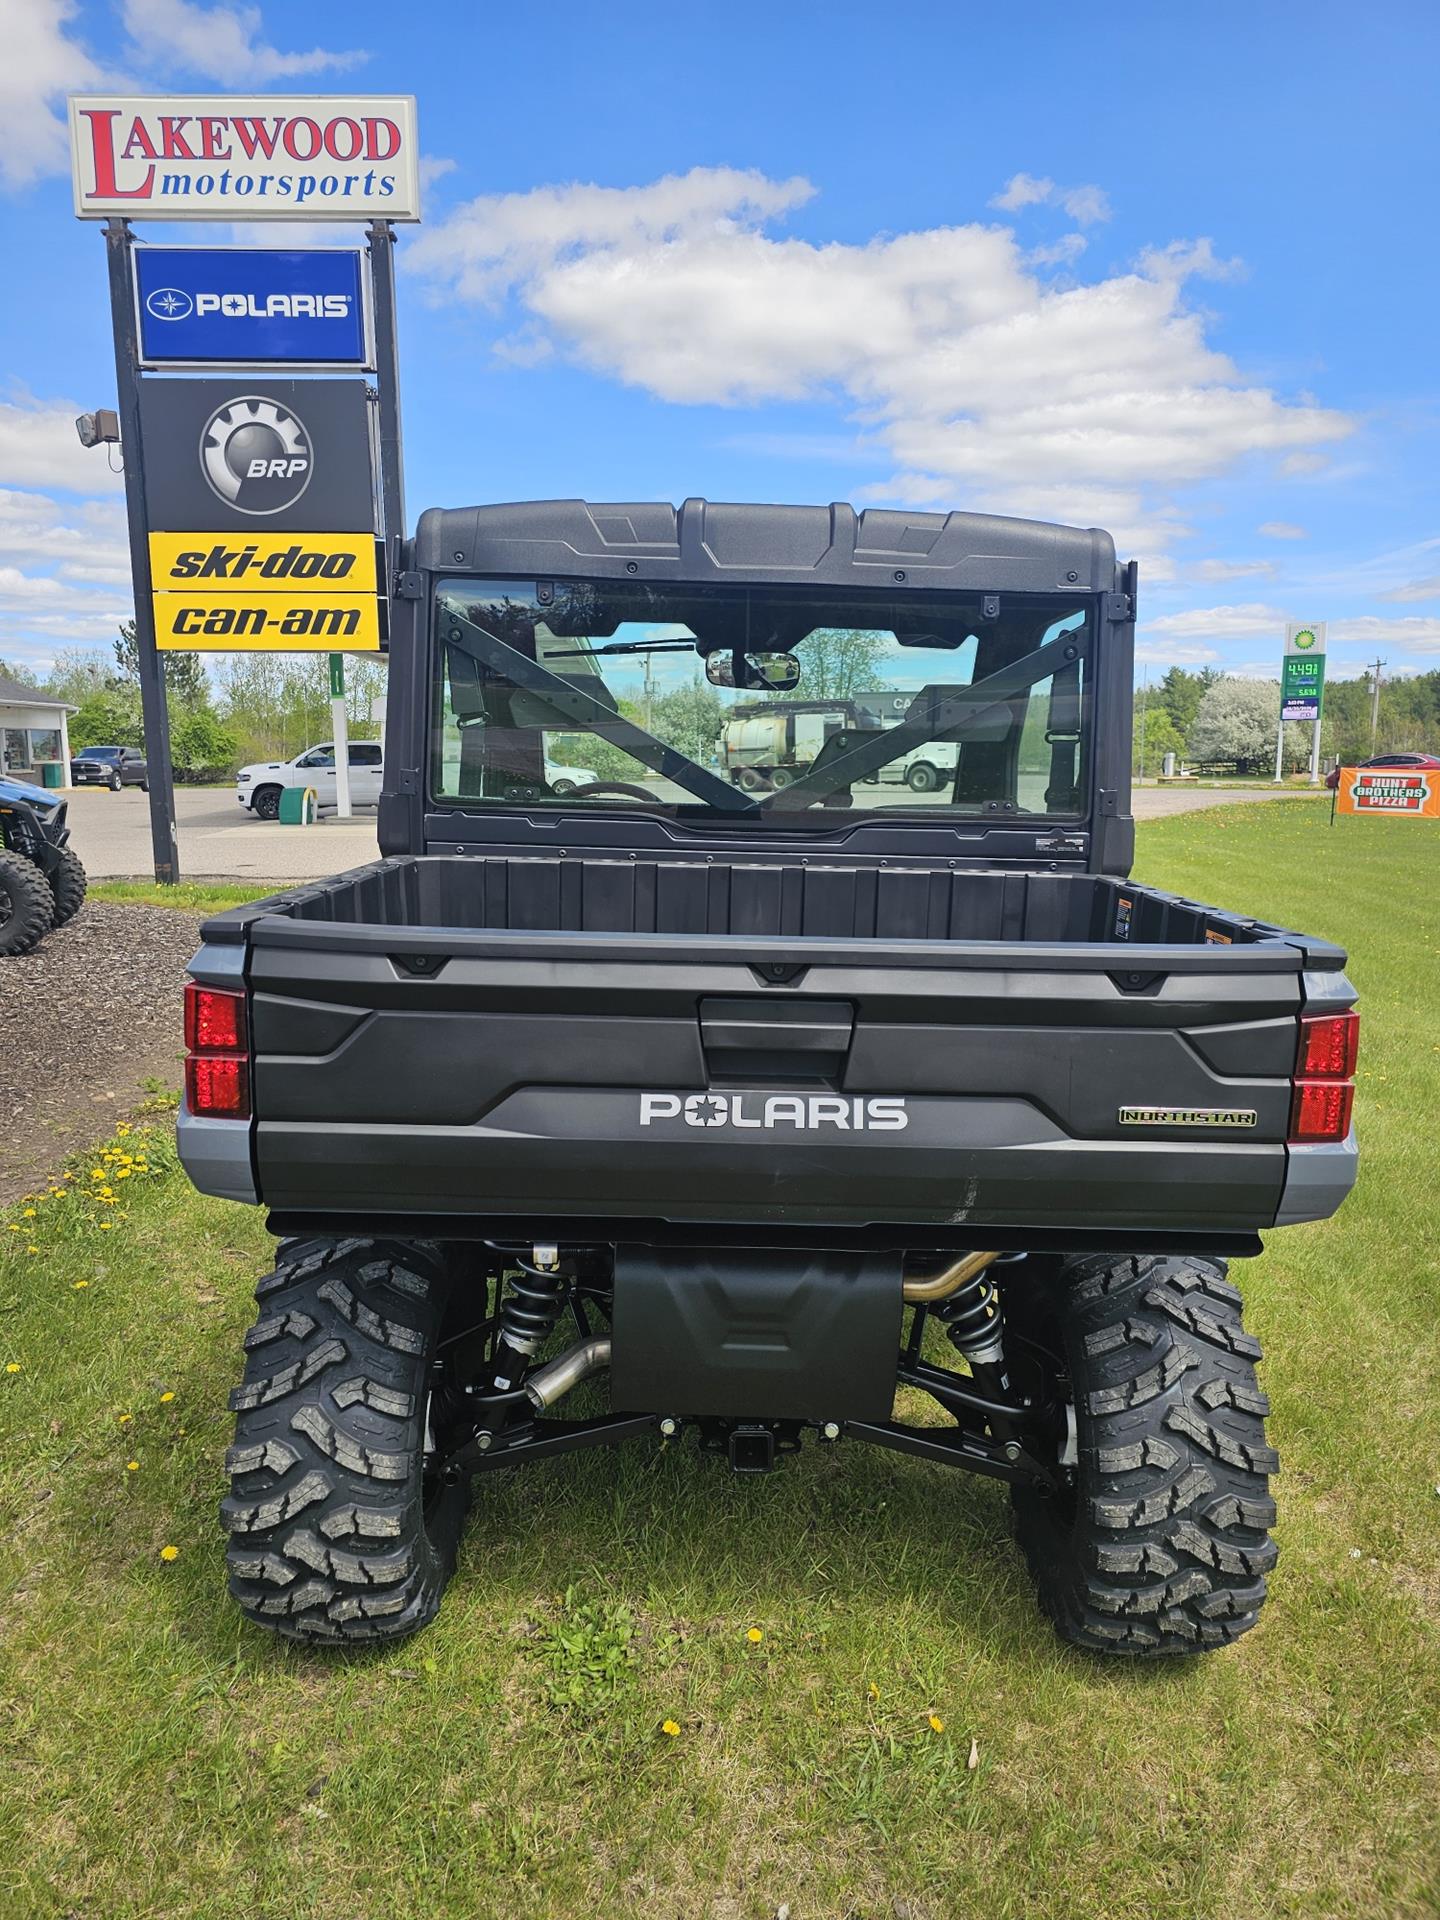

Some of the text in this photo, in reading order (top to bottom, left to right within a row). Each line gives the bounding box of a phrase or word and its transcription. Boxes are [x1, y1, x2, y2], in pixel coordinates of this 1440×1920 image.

[79, 110, 402, 199] LAKEWOOD
[161, 169, 396, 202] motorsports
[196, 294, 348, 318] POLARIS
[246, 459, 308, 478] BRP
[169, 545, 357, 579] ski-doo
[171, 608, 361, 636] can-am
[1356, 787, 1424, 798] BROTHERS
[1371, 778, 1409, 788] HUNT
[1369, 796, 1409, 807] PIZZA
[639, 1093, 909, 1130] POLARIS
[1125, 1110, 1252, 1124] NORTHSTAR
